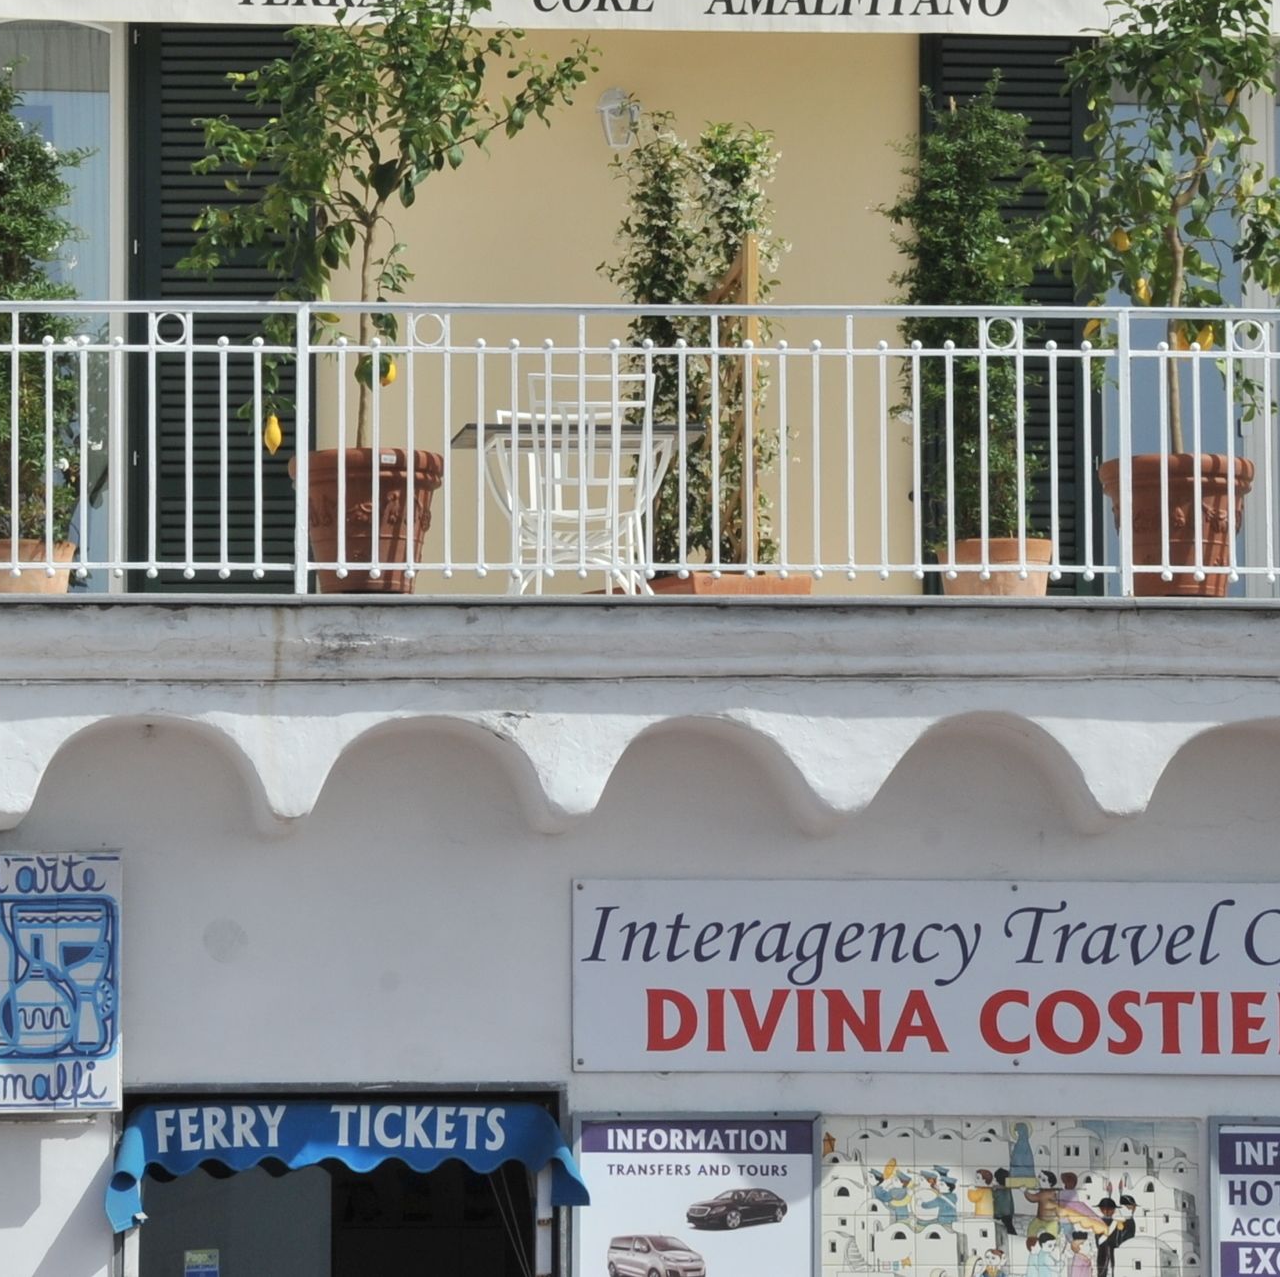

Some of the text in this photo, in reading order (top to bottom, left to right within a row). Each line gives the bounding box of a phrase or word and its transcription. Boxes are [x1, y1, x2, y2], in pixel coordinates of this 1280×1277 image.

[581, 905, 982, 987] Interagency
[1003, 899, 1236, 966] Travel
[646, 988, 950, 1053] DIVINA
[155, 1105, 506, 1154] FERRY TICKETS
[607, 1128, 787, 1152] INFORMATION
[607, 1163, 788, 1178] TRANSFERS AND TOURS
